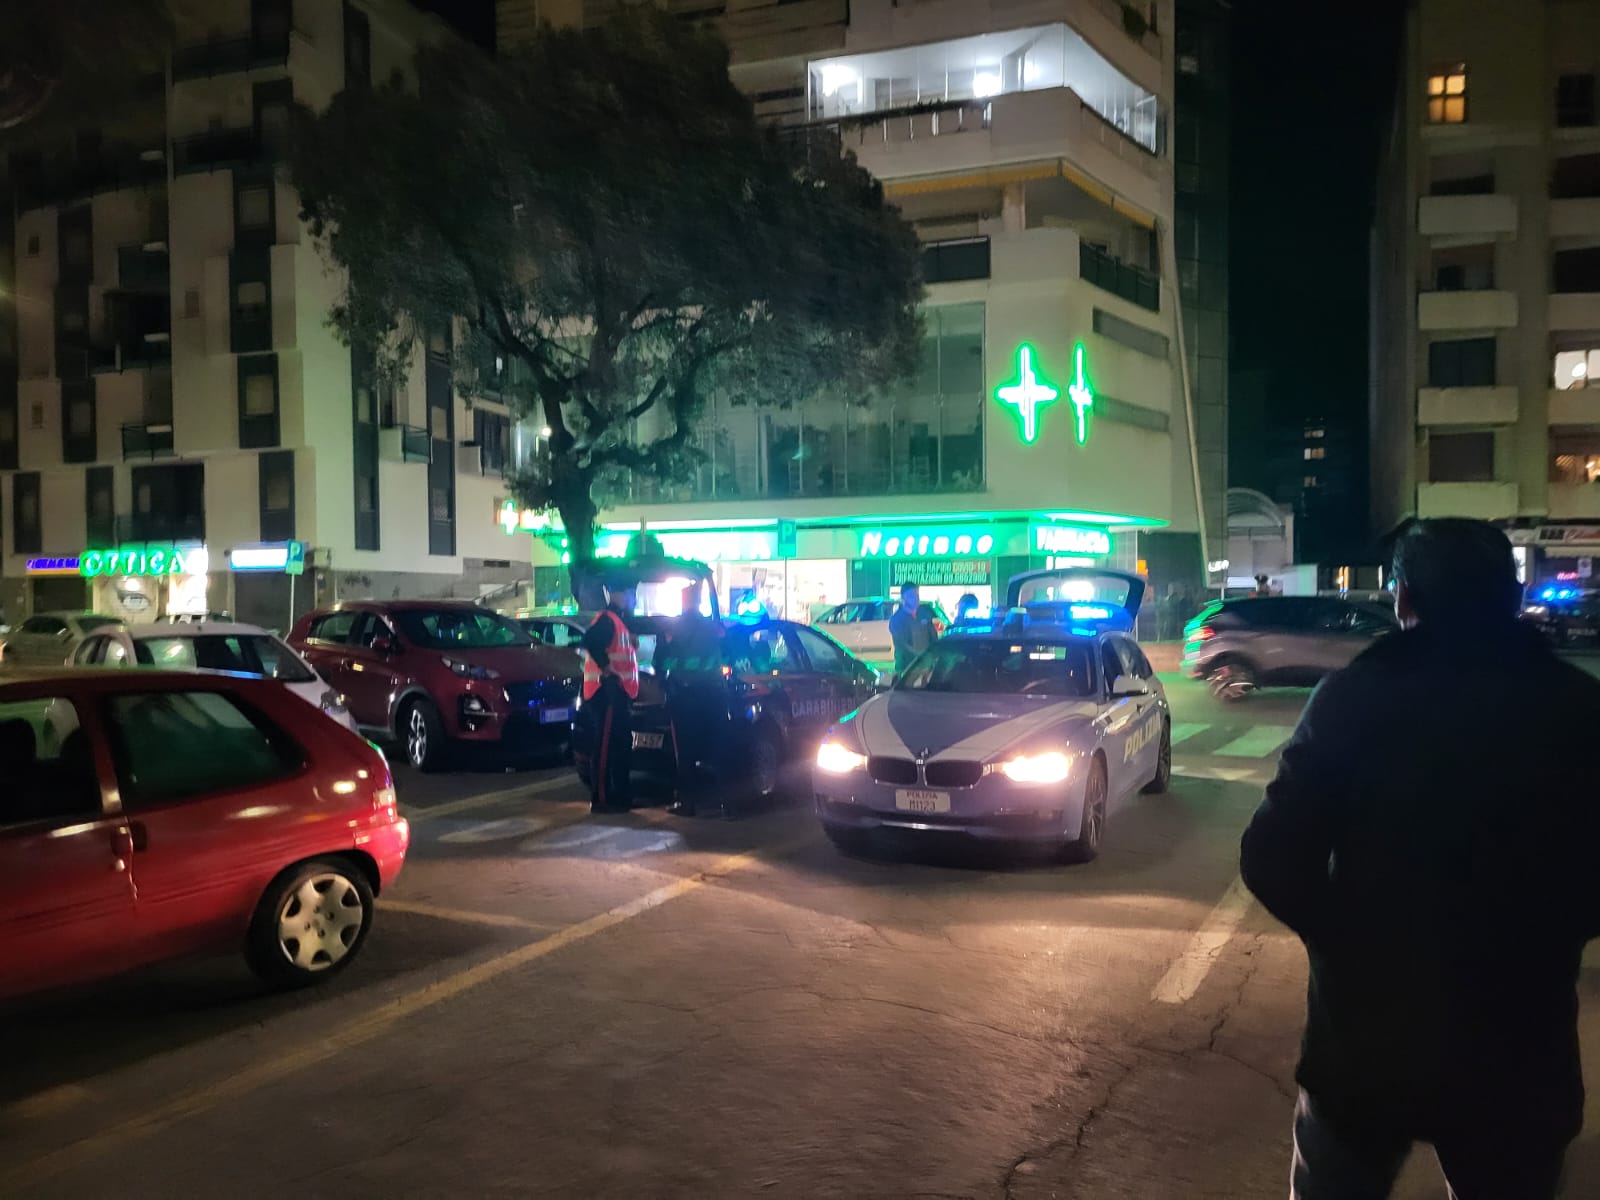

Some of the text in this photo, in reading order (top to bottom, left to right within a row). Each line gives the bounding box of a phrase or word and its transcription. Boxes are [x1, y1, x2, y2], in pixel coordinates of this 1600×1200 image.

[782, 523, 793, 540] P
[290, 542, 300, 558] P
[83, 550, 186, 577] OTTICA
[894, 561, 926, 573] TAMPONE
[926, 560, 952, 573] RAPIDO
[791, 696, 856, 718] CARABINIERI
[906, 791, 938, 800] POLIZIA
